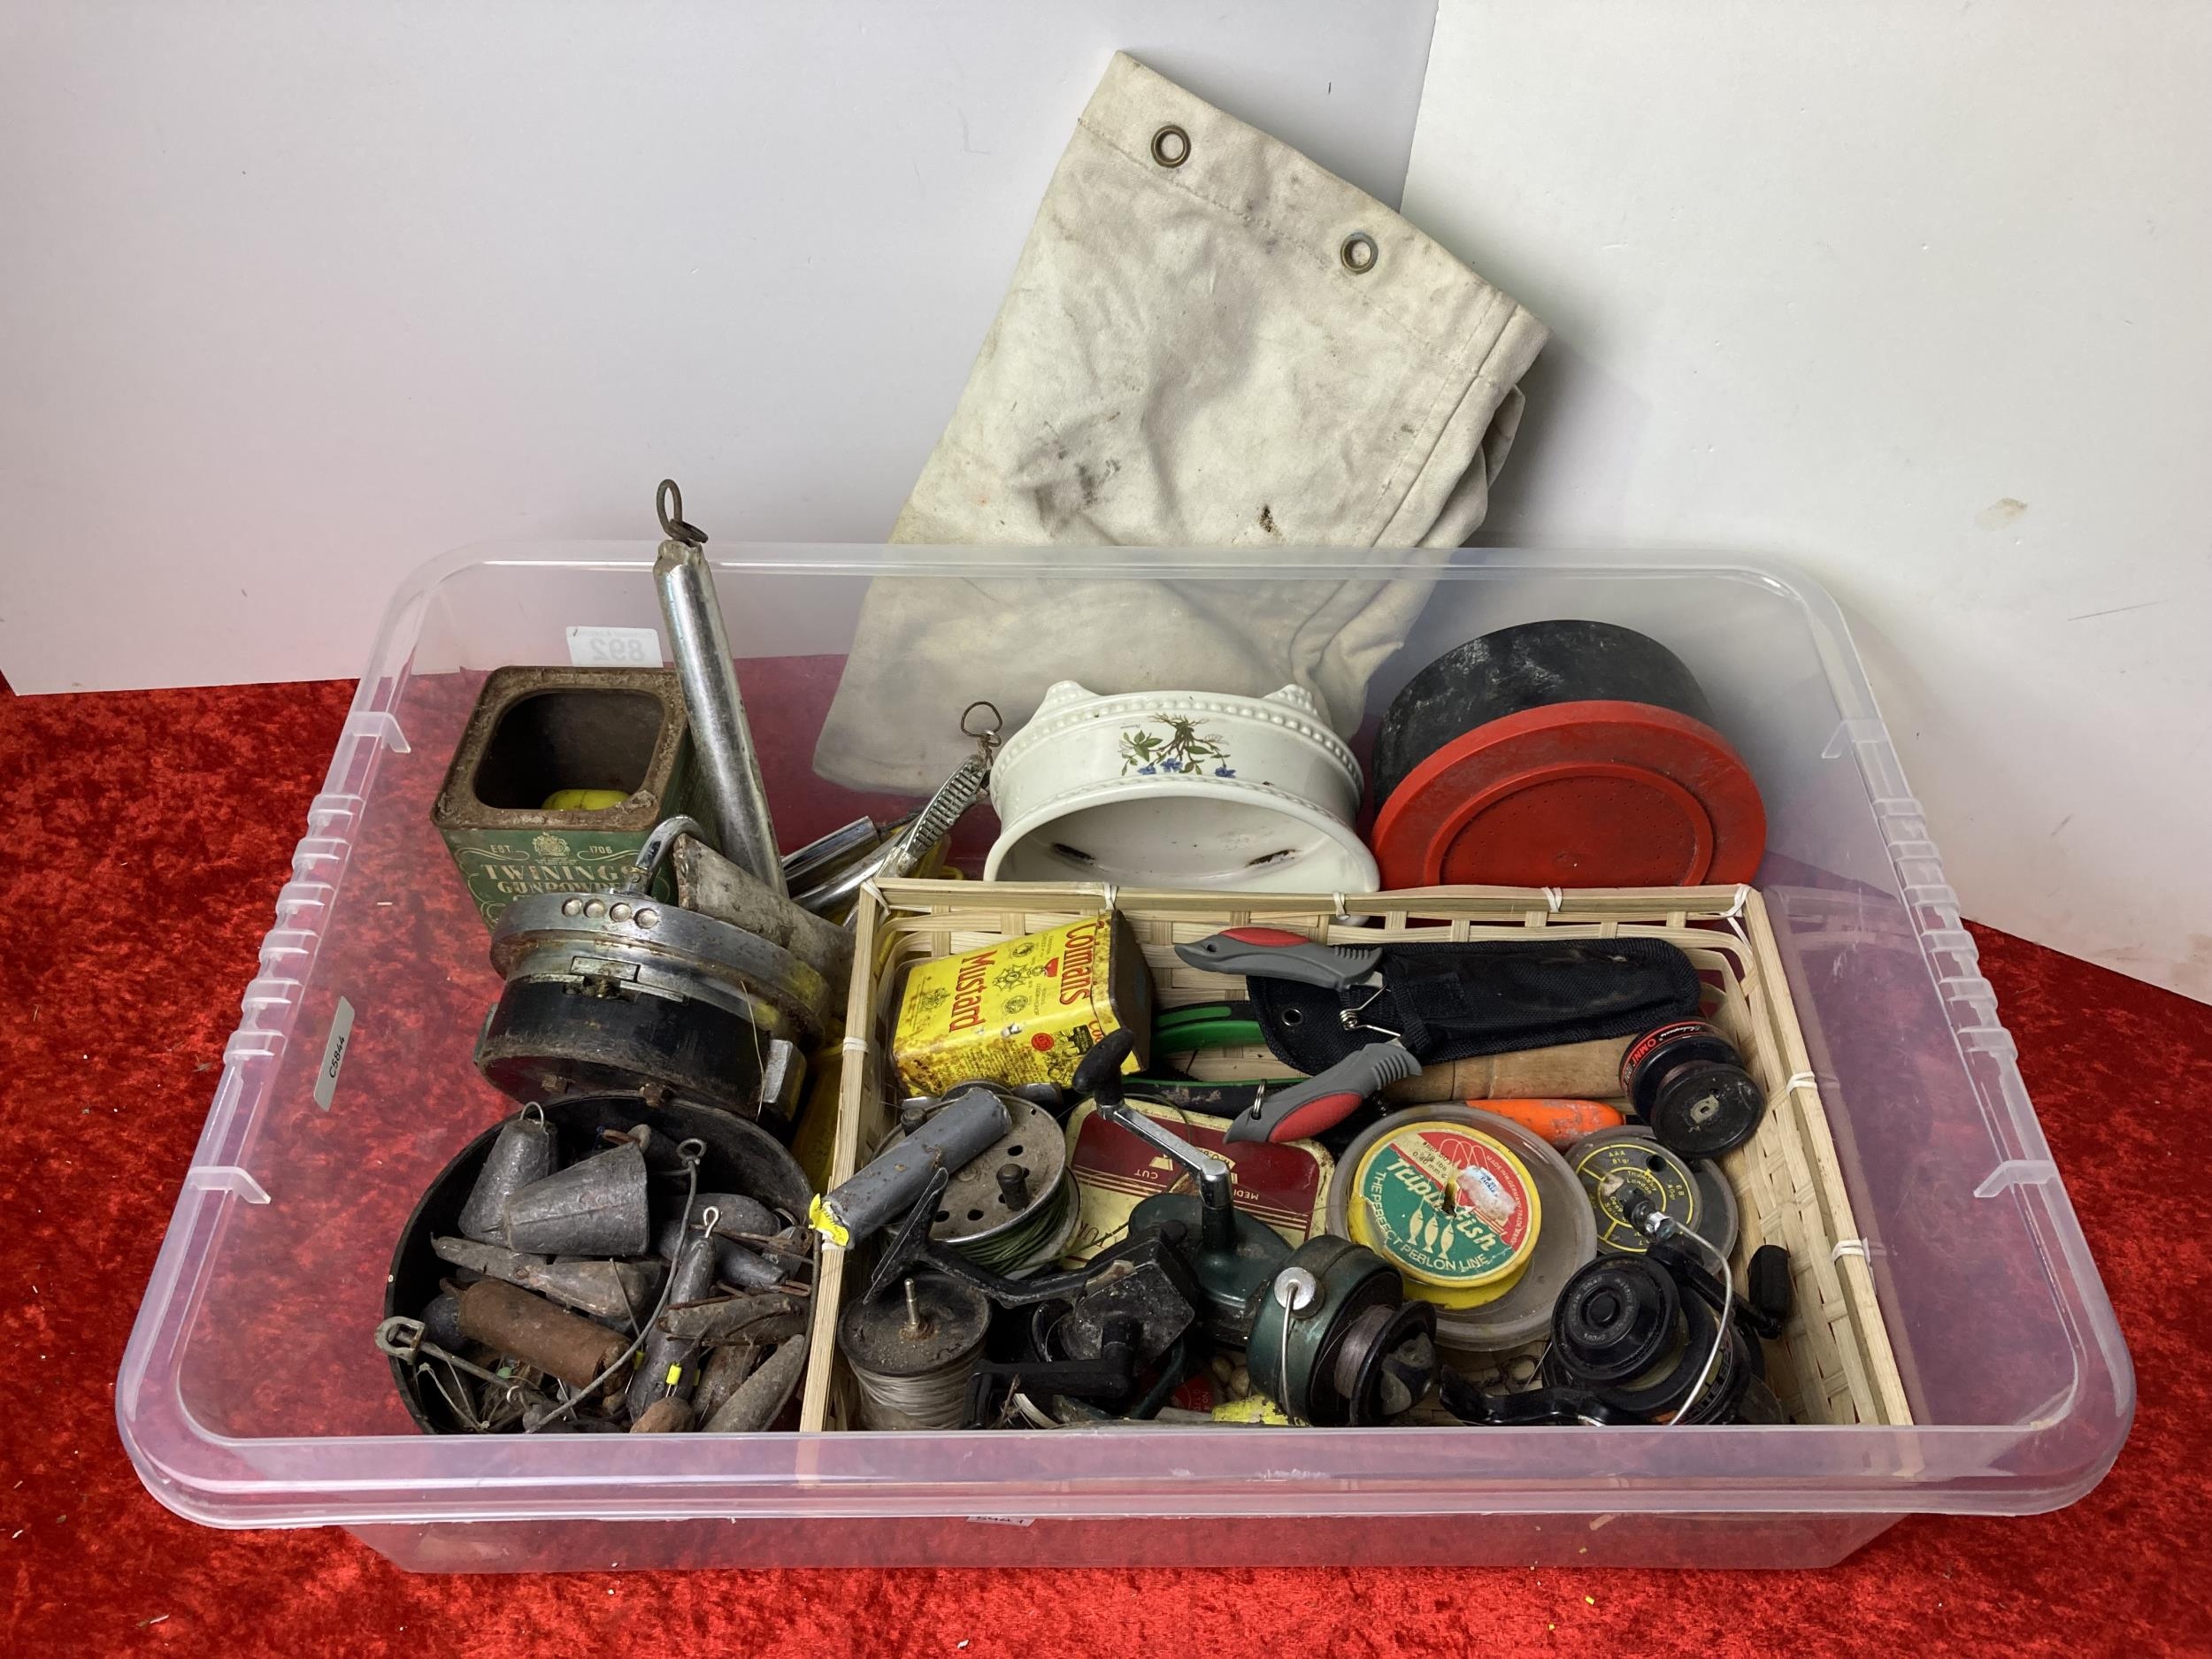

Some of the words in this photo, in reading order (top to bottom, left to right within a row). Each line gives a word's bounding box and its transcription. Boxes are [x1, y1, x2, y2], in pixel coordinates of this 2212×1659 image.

[589, 844, 613, 855] 1706
[949, 950, 998, 1033] Mustard
[328, 1035, 345, 1079] C5844
[1632, 1038, 1657, 1064] OMNI
[1134, 1169, 1158, 1180] CUT
[1233, 1189, 1259, 1201] MEDI
[1371, 1171, 1386, 1194] THE
[1401, 1242, 1456, 1272] PERLON
[1458, 1253, 1490, 1273] LINE
